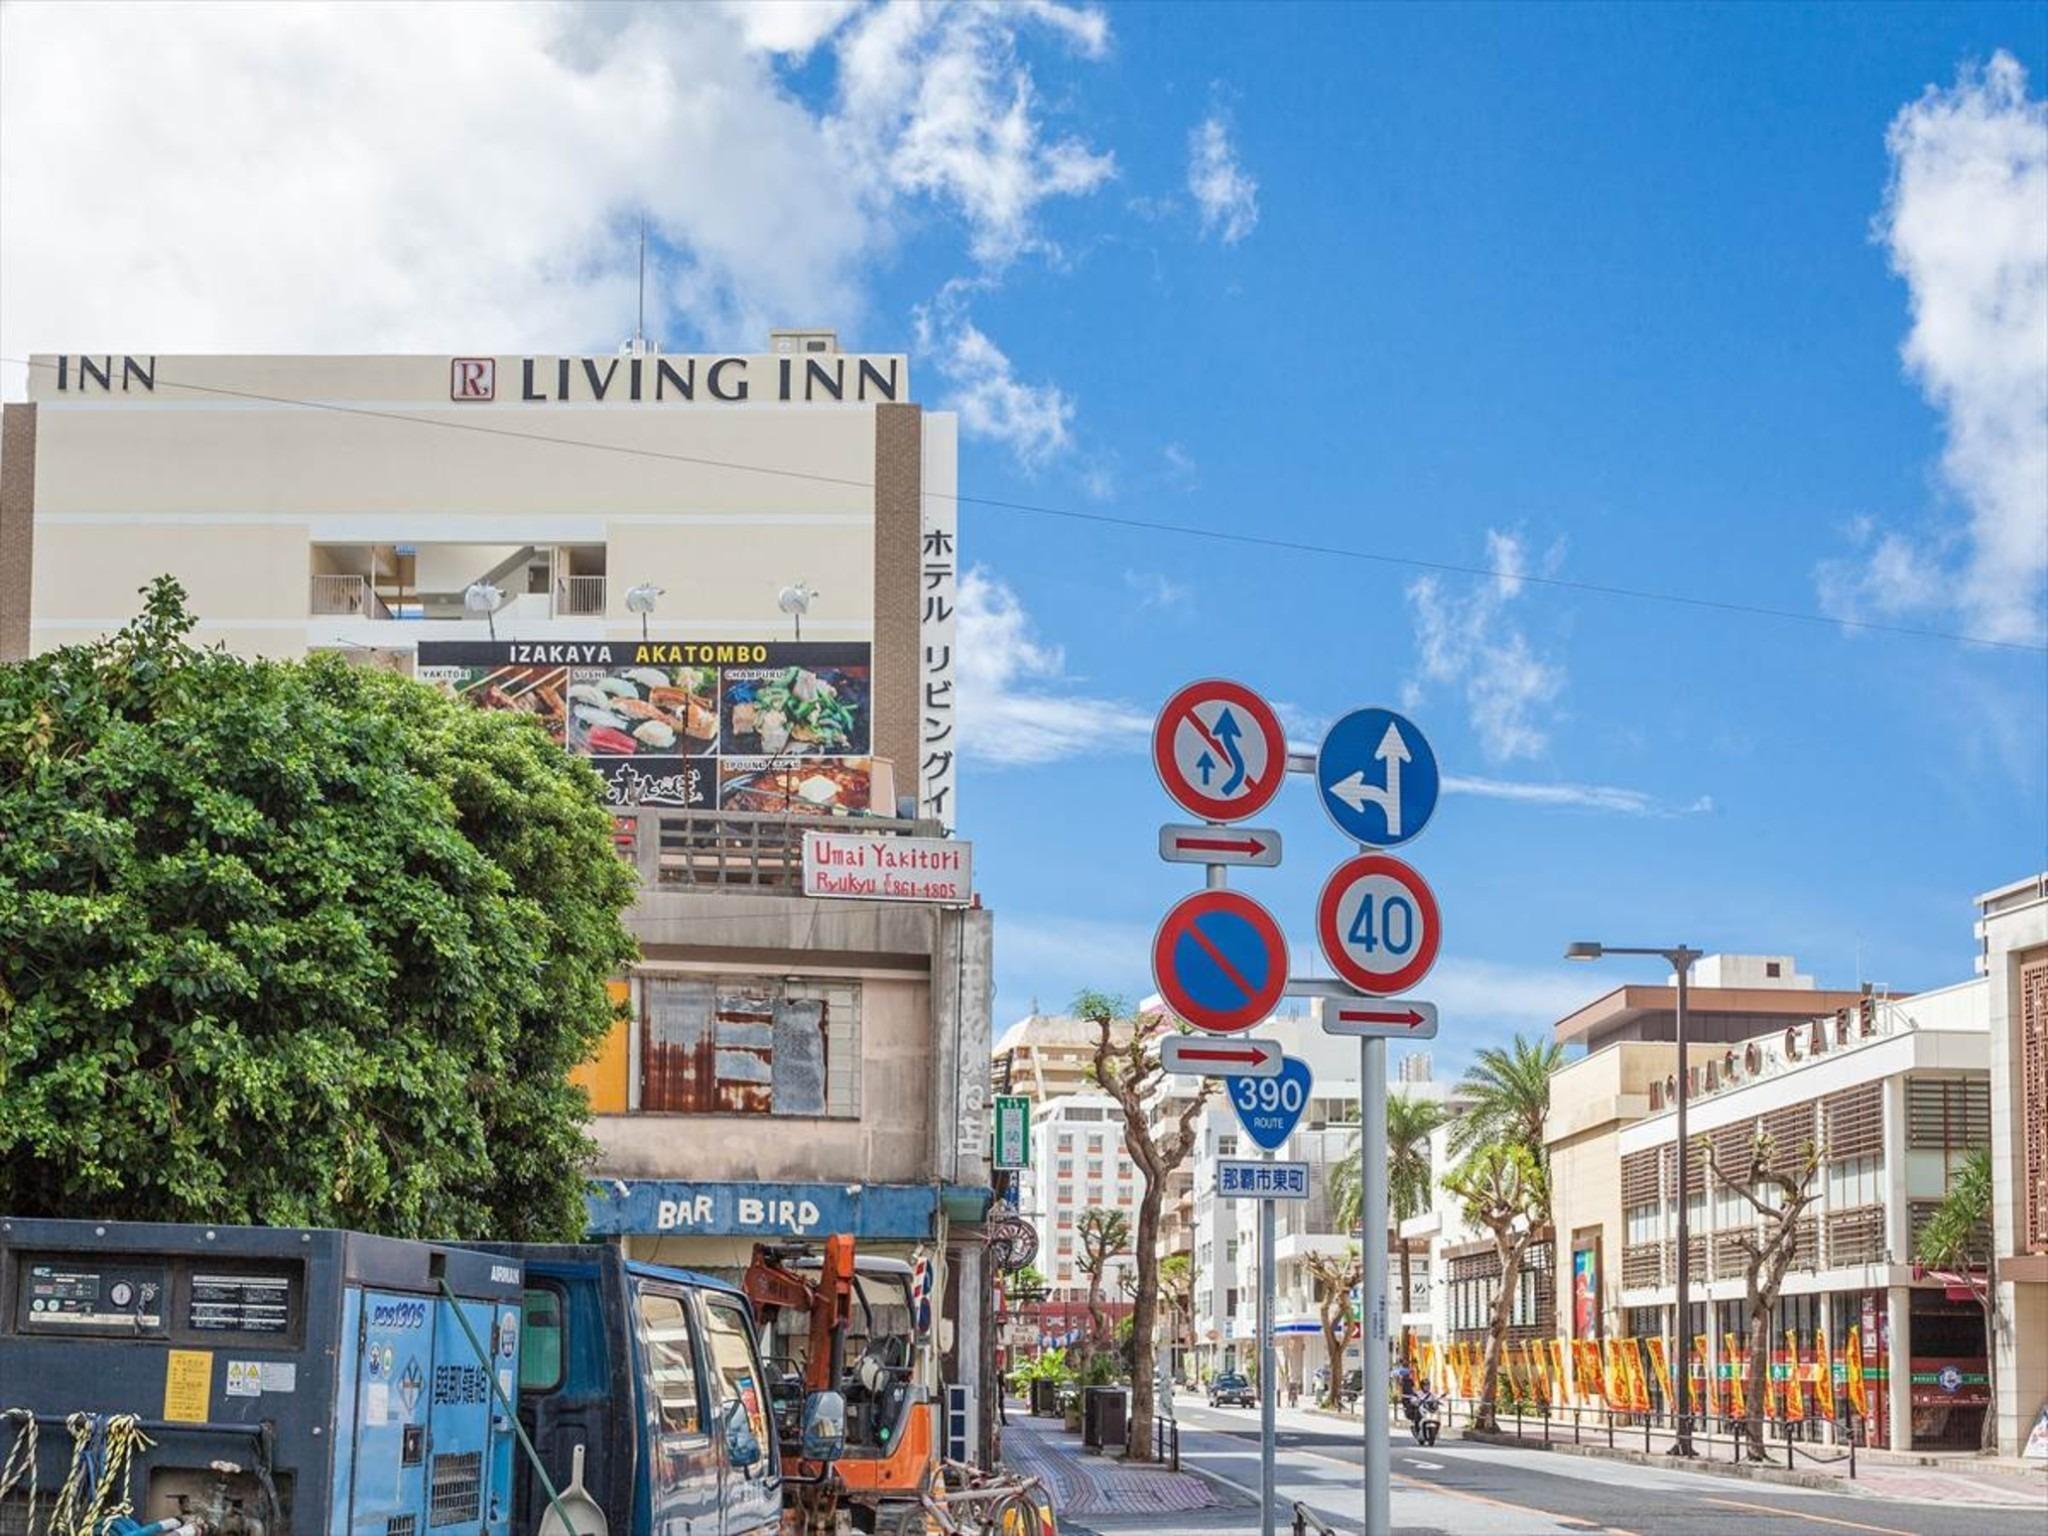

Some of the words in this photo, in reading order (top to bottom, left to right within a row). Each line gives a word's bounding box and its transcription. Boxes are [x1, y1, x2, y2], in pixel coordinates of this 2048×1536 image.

[57, 355, 156, 391] INN
[521, 357, 749, 401] LIVING
[778, 357, 898, 401] INN
[922, 529, 953, 624] ホテル
[509, 645, 612, 664] IZAKAYA
[636, 645, 767, 664] AKATOMBO
[573, 669, 607, 680] SUSHI
[922, 645, 956, 839] リビングイ
[815, 841, 864, 868] Umai
[871, 843, 959, 871] Yakitori
[816, 871, 876, 895] Ryukyu
[1348, 893, 1413, 955] 40
[1238, 1077, 1303, 1112] 390
[1253, 1117, 1284, 1129] ROUTE
[1222, 1167, 1304, 1192] 那覇市東町
[658, 1194, 713, 1230] BAR
[738, 1198, 820, 1235] BIRD
